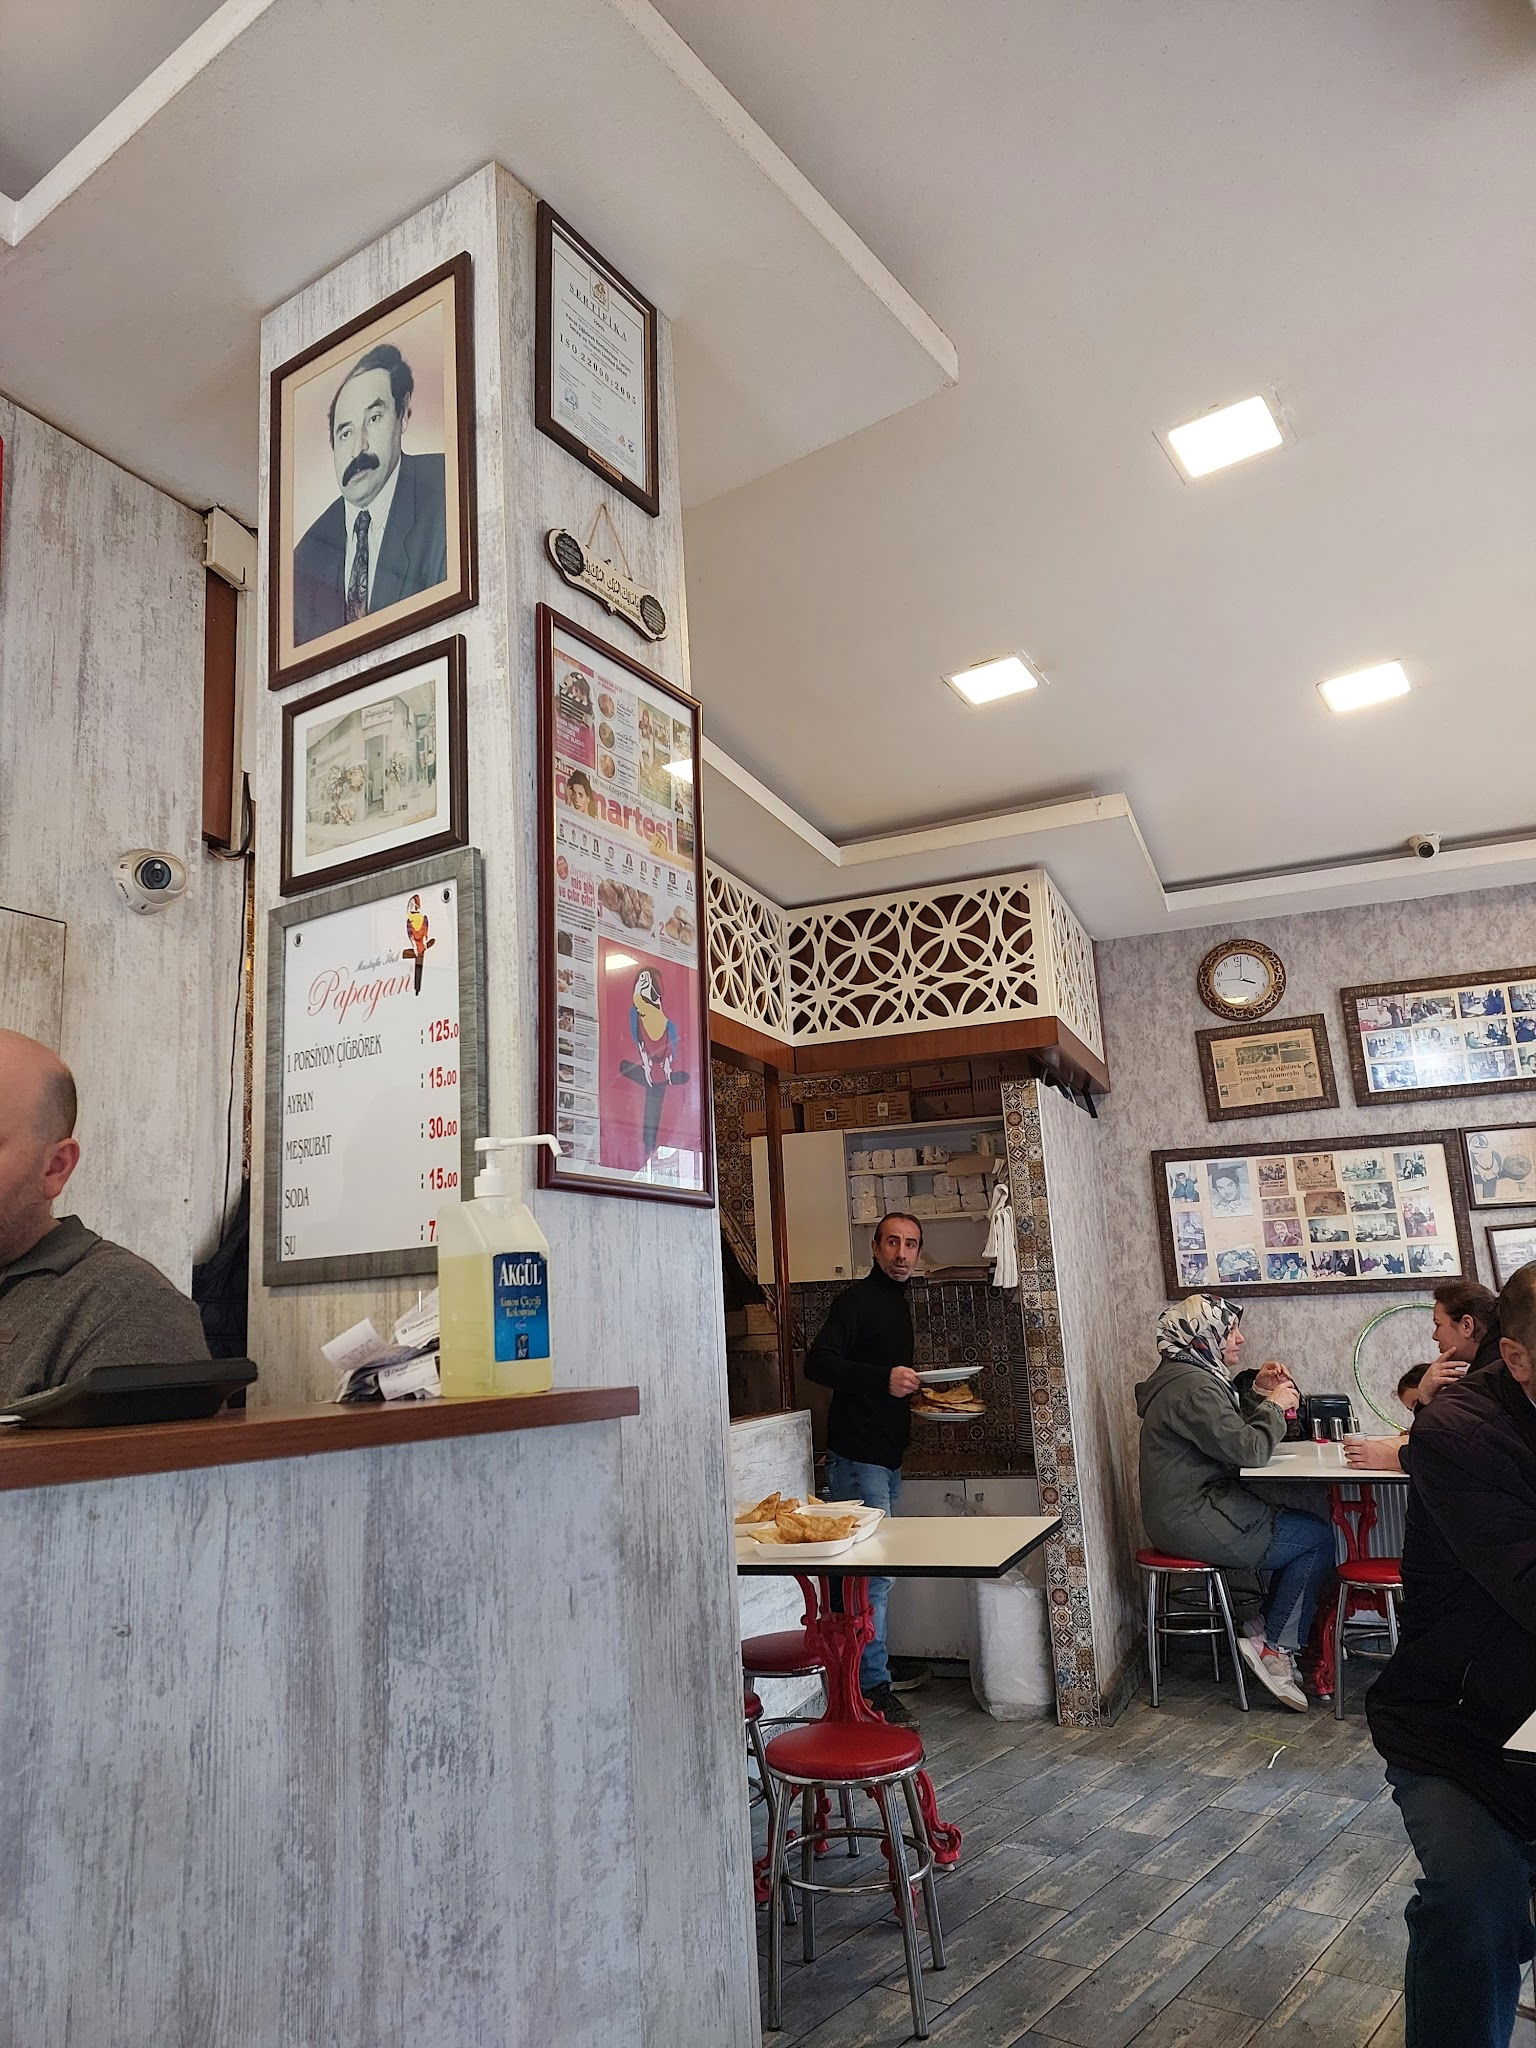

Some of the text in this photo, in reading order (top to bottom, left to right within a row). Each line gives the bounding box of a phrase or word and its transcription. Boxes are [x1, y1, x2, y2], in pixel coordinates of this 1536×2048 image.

[560, 333, 578, 354] ISO
[307, 966, 411, 1024] Papağan
[287, 1055, 291, 1073] 1
[293, 1042, 335, 1072] PORSİYON
[336, 1033, 382, 1068] ÇİĞBÖREK
[286, 1091, 314, 1115] AYRAN
[429, 1066, 457, 1089] 15.00
[285, 1134, 332, 1164] MEŞRUBAT
[429, 1116, 458, 1139] 30.00
[284, 1186, 310, 1209] SODA
[429, 1167, 458, 1190] 15.00
[284, 1234, 296, 1256] SU
[498, 1258, 542, 1286] AKGÜL
